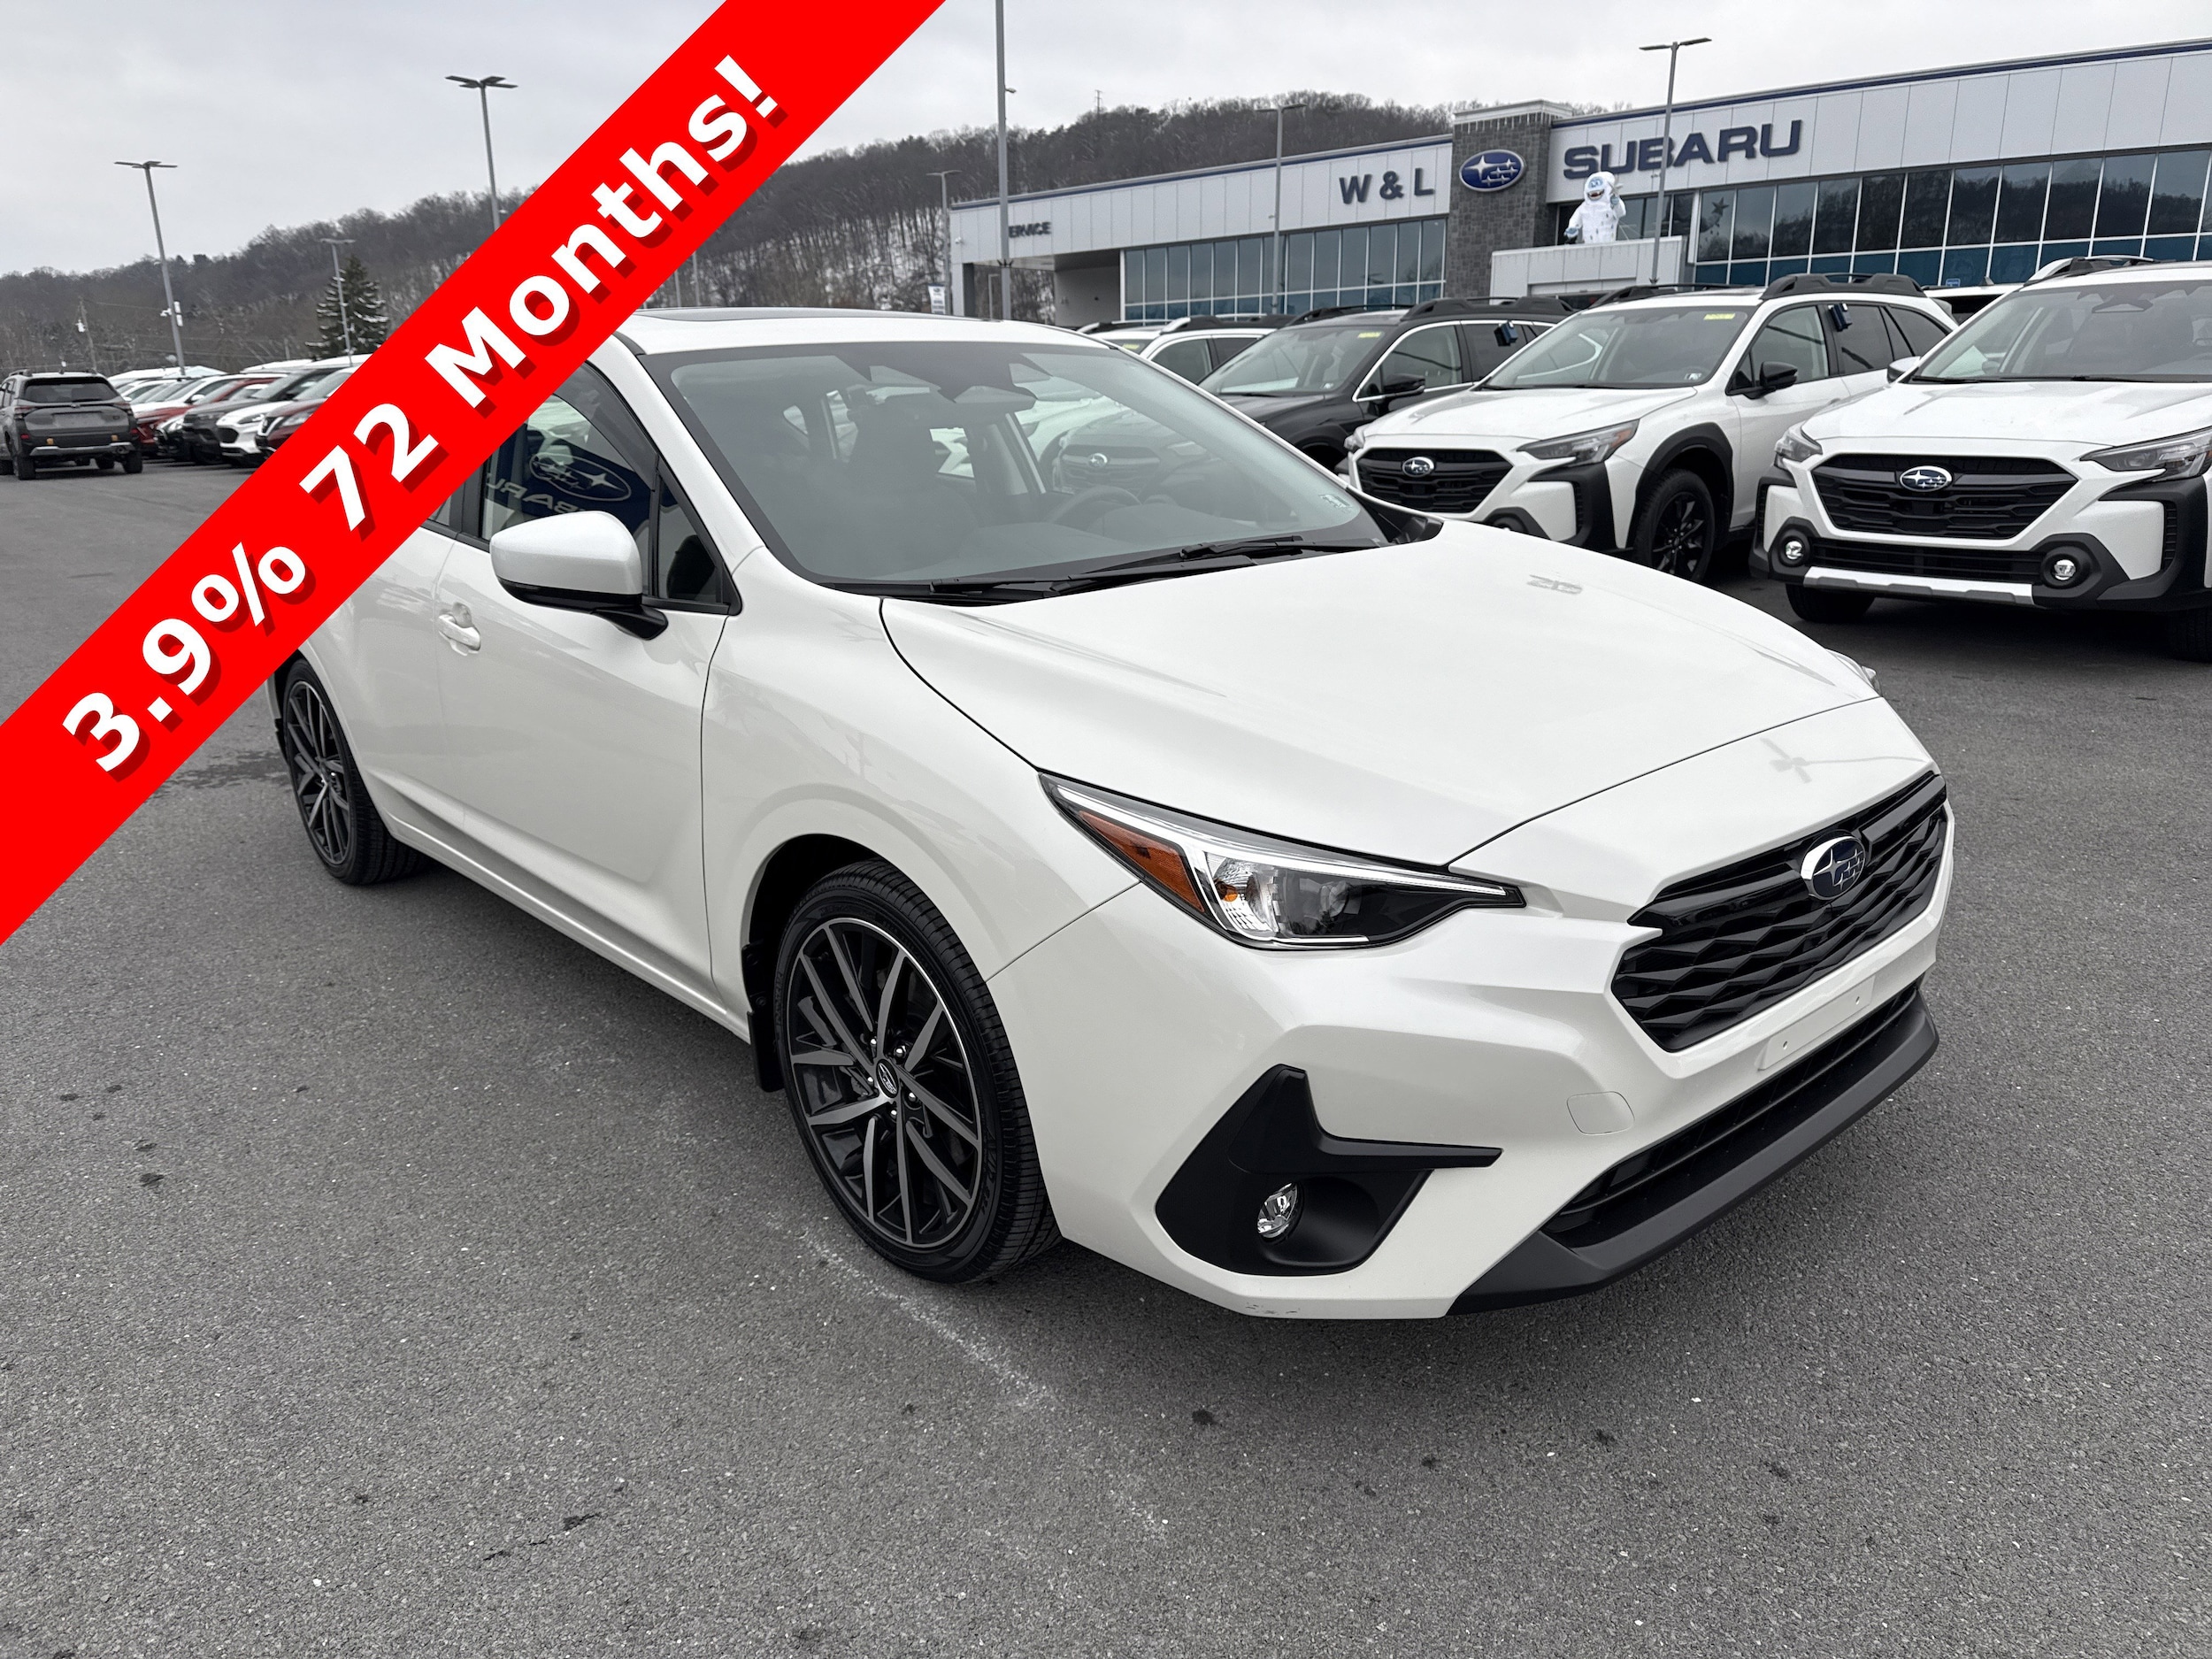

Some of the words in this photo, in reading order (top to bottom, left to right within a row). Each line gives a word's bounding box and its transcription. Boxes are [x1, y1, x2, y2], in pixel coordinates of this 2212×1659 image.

[1563, 119, 1802, 180] SUBARU
[1339, 173, 1372, 204] W
[1379, 171, 1404, 200] &
[1414, 167, 1435, 196] L
[1008, 221, 1052, 238] ERVICE
